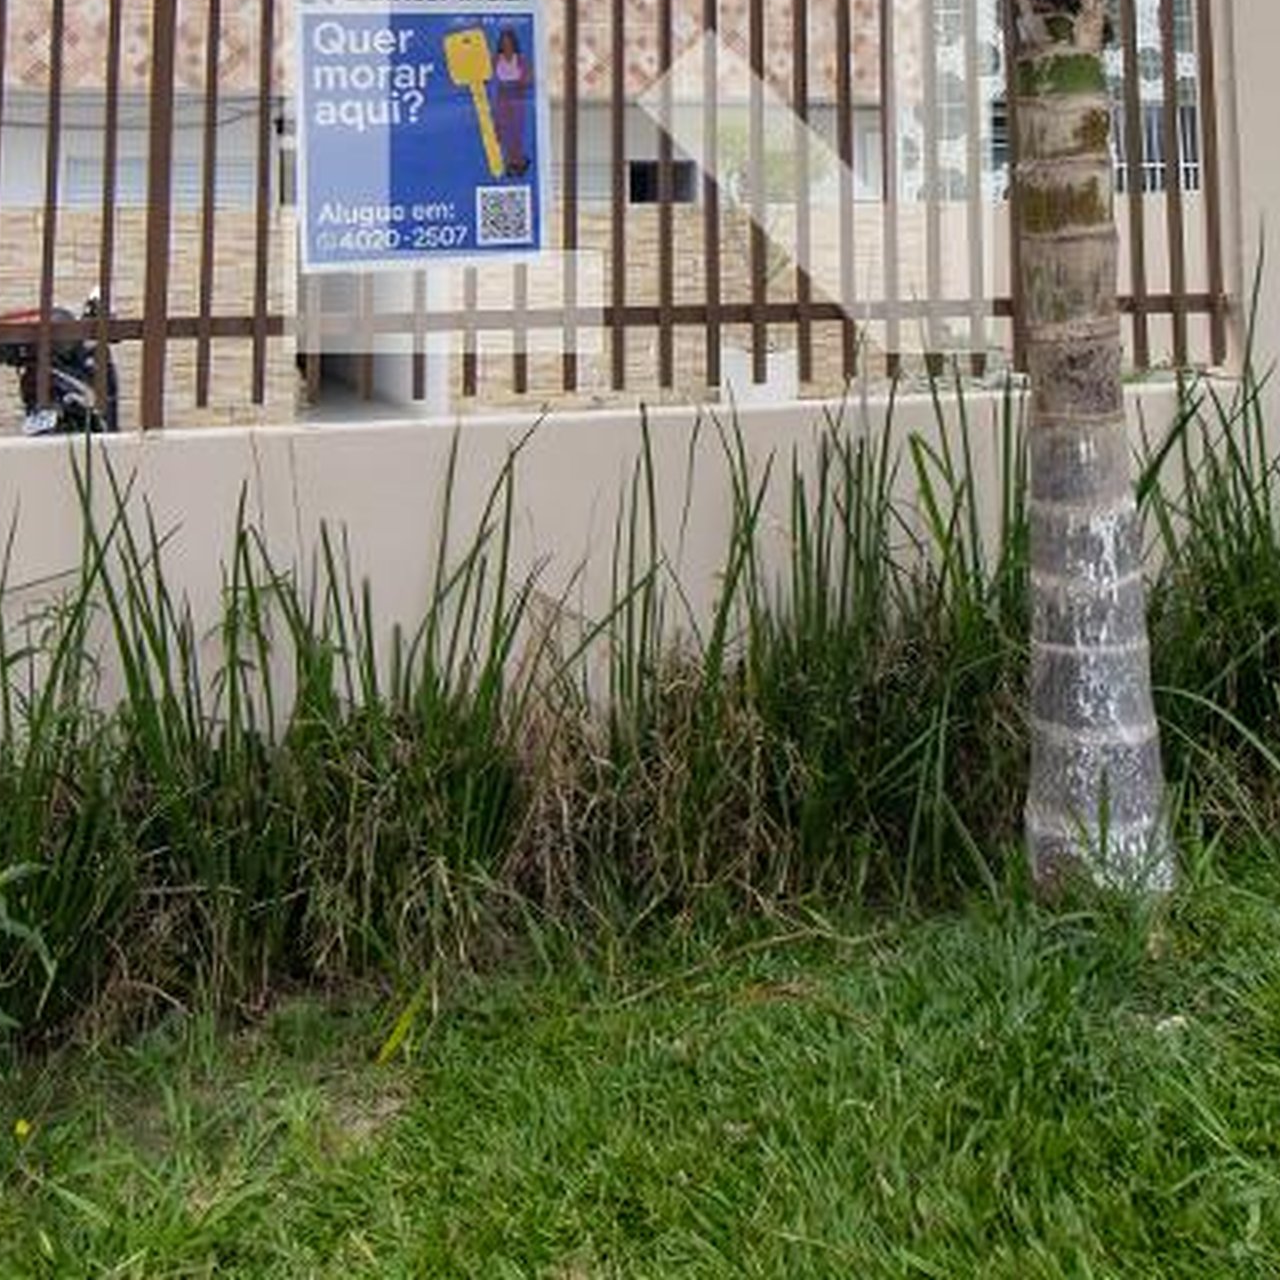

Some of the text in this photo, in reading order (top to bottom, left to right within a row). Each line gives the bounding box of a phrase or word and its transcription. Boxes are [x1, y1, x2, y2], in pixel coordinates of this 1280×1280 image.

[313, 22, 414, 56] Quer
[314, 63, 434, 89] morar
[315, 91, 424, 132] aqui?
